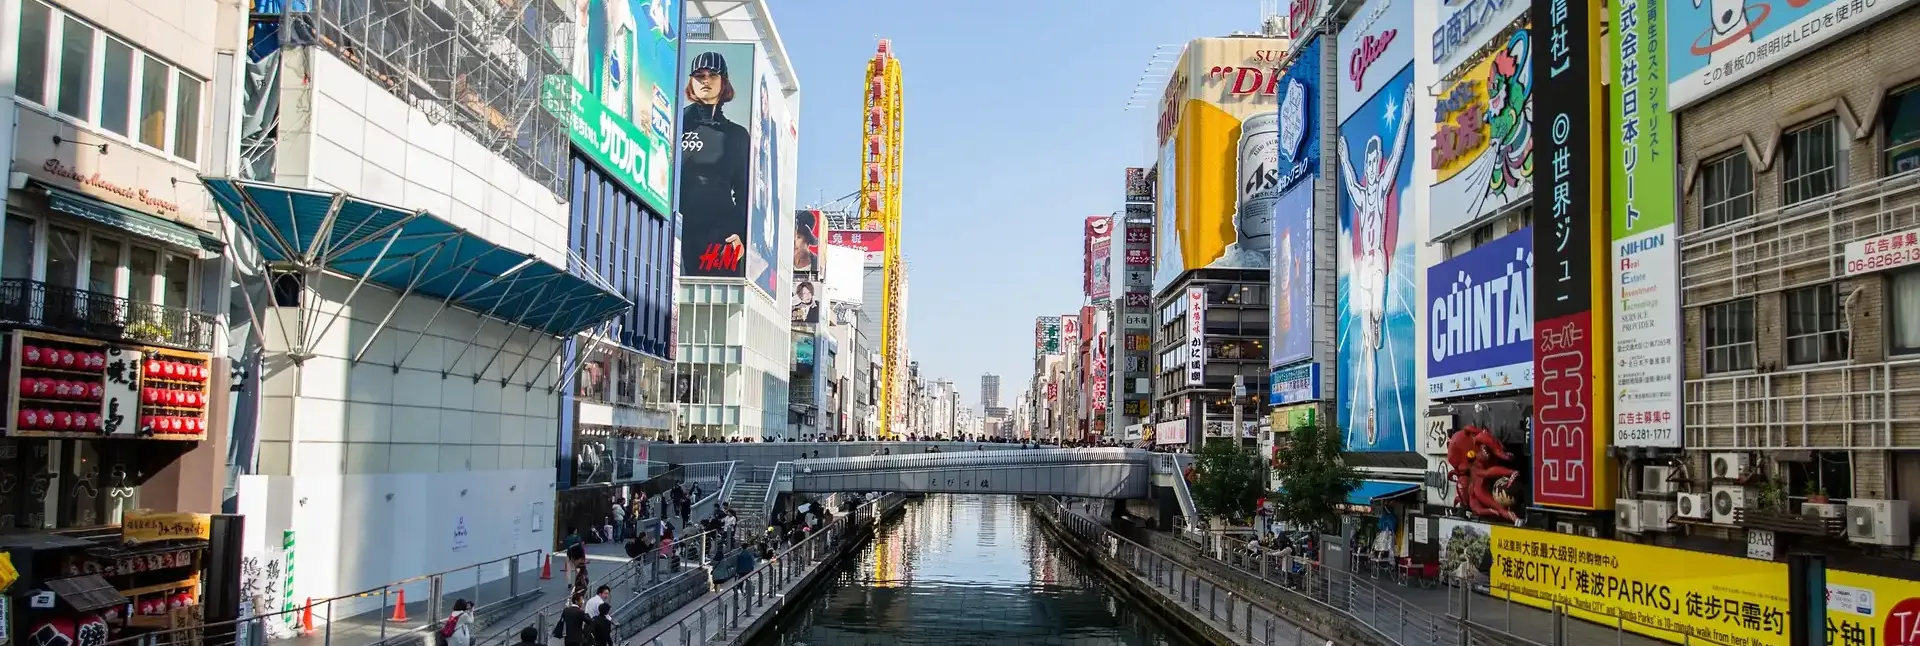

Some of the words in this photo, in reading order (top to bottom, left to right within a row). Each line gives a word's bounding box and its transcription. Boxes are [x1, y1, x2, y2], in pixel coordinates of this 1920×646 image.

[1350, 29, 1397, 92] Glico
[1620, 0, 1640, 230] 式会社日本リート
[1621, 234, 1664, 257] NIHON
[1864, 232, 1918, 255] 広告募集
[700, 243, 741, 271] H&M
[1621, 258, 1640, 271] Real
[1622, 272, 1646, 285] Estate
[1622, 285, 1657, 298] Investment
[1621, 299, 1658, 311] Technology
[1622, 311, 1648, 322] SERVICE
[1622, 320, 1655, 333] PROVIDER
[1541, 321, 1583, 353] スーパー
[1618, 410, 1671, 425] 広告主募集中
[1748, 531, 1774, 547] BAR
[1657, 614, 1663, 625] is
[1664, 617, 1695, 636] 10-minute
[1697, 627, 1712, 639] walk
[1713, 629, 1729, 642] from
[1731, 632, 1750, 646] here!
